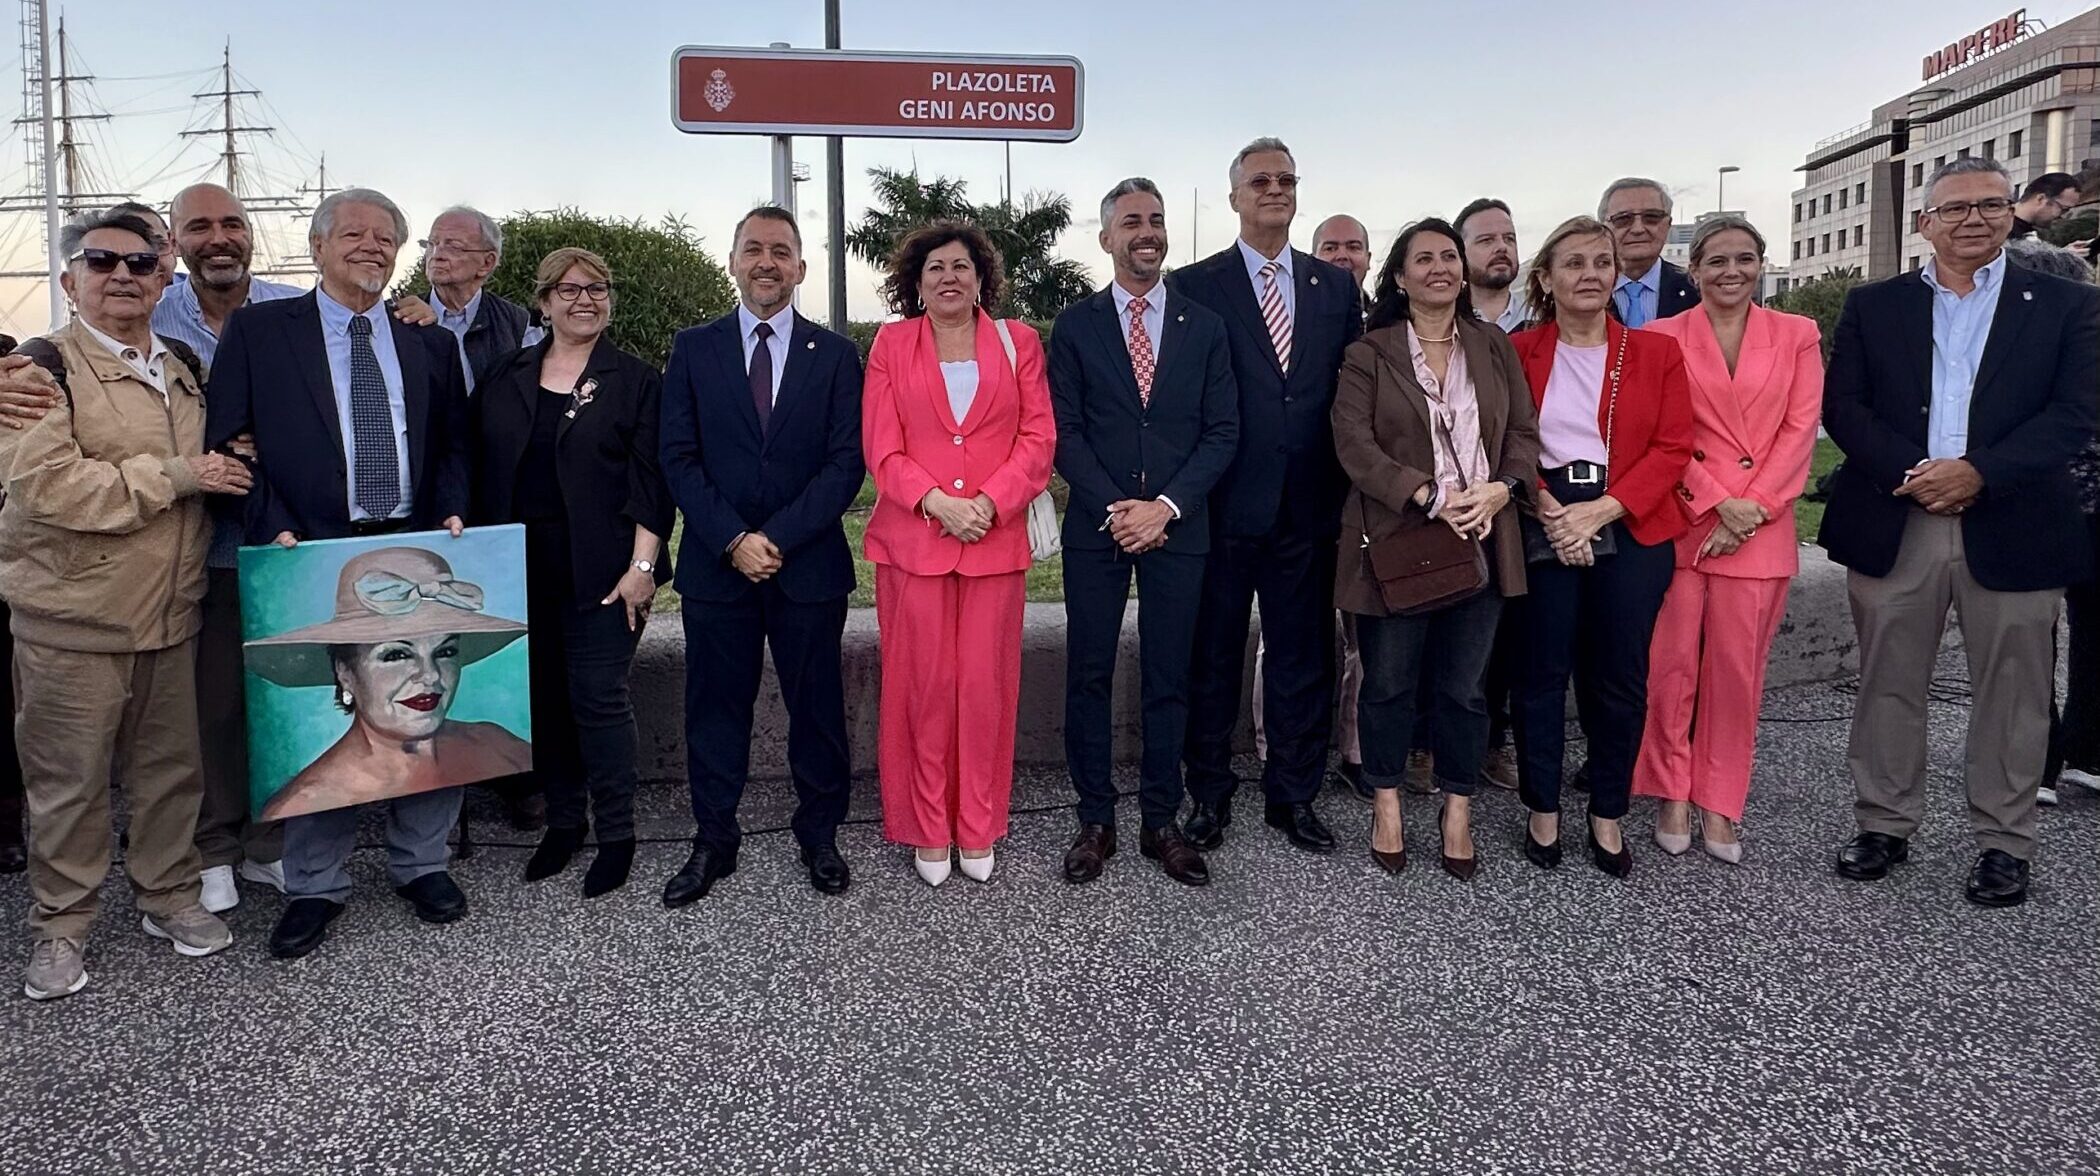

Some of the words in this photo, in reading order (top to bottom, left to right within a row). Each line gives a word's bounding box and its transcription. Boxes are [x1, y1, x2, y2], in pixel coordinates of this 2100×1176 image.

[1922, 8, 2026, 81] MAPFRE
[931, 71, 1056, 94] PLAZOLETA
[899, 99, 954, 120] GENI
[960, 101, 1055, 123] AFONSO
